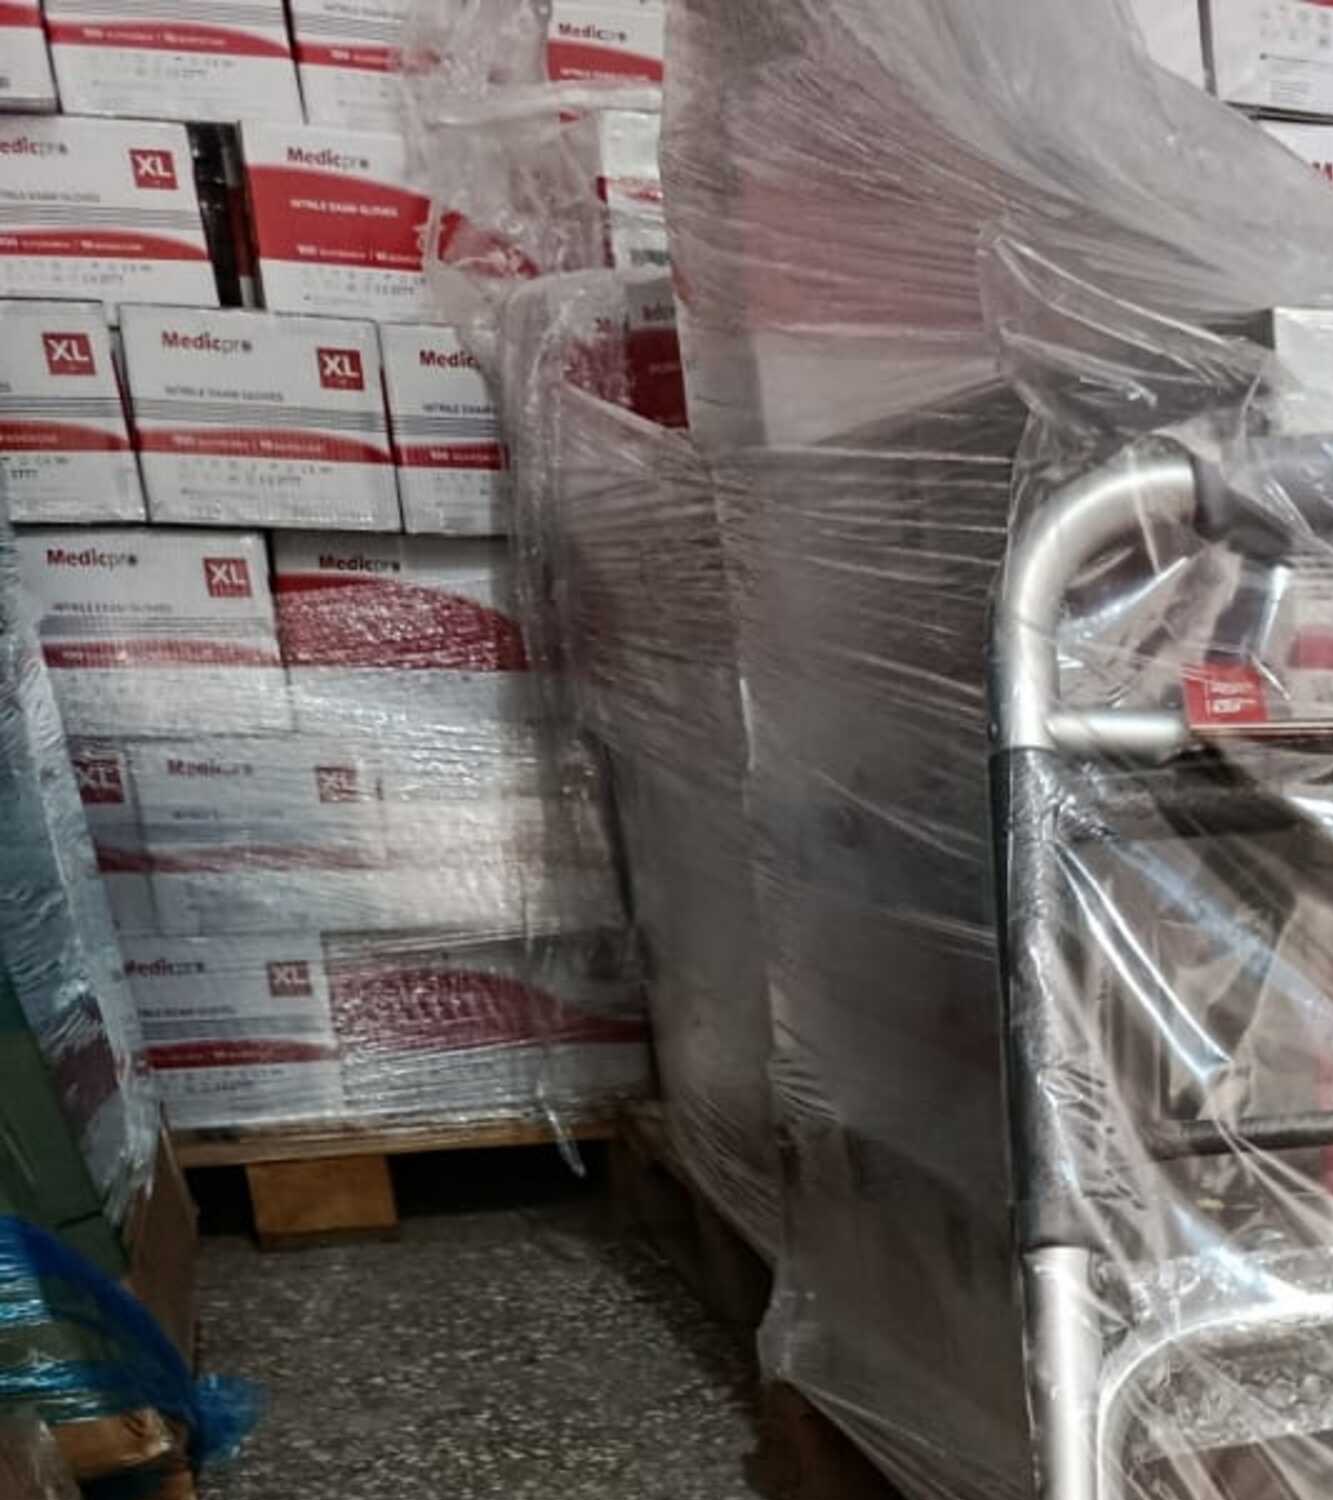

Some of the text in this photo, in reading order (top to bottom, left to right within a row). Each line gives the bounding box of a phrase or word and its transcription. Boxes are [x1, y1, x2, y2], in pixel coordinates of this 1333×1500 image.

[135, 155, 173, 177] XL
[47, 334, 90, 363] XL
[320, 354, 361, 379] XL
[208, 562, 247, 586] XL
